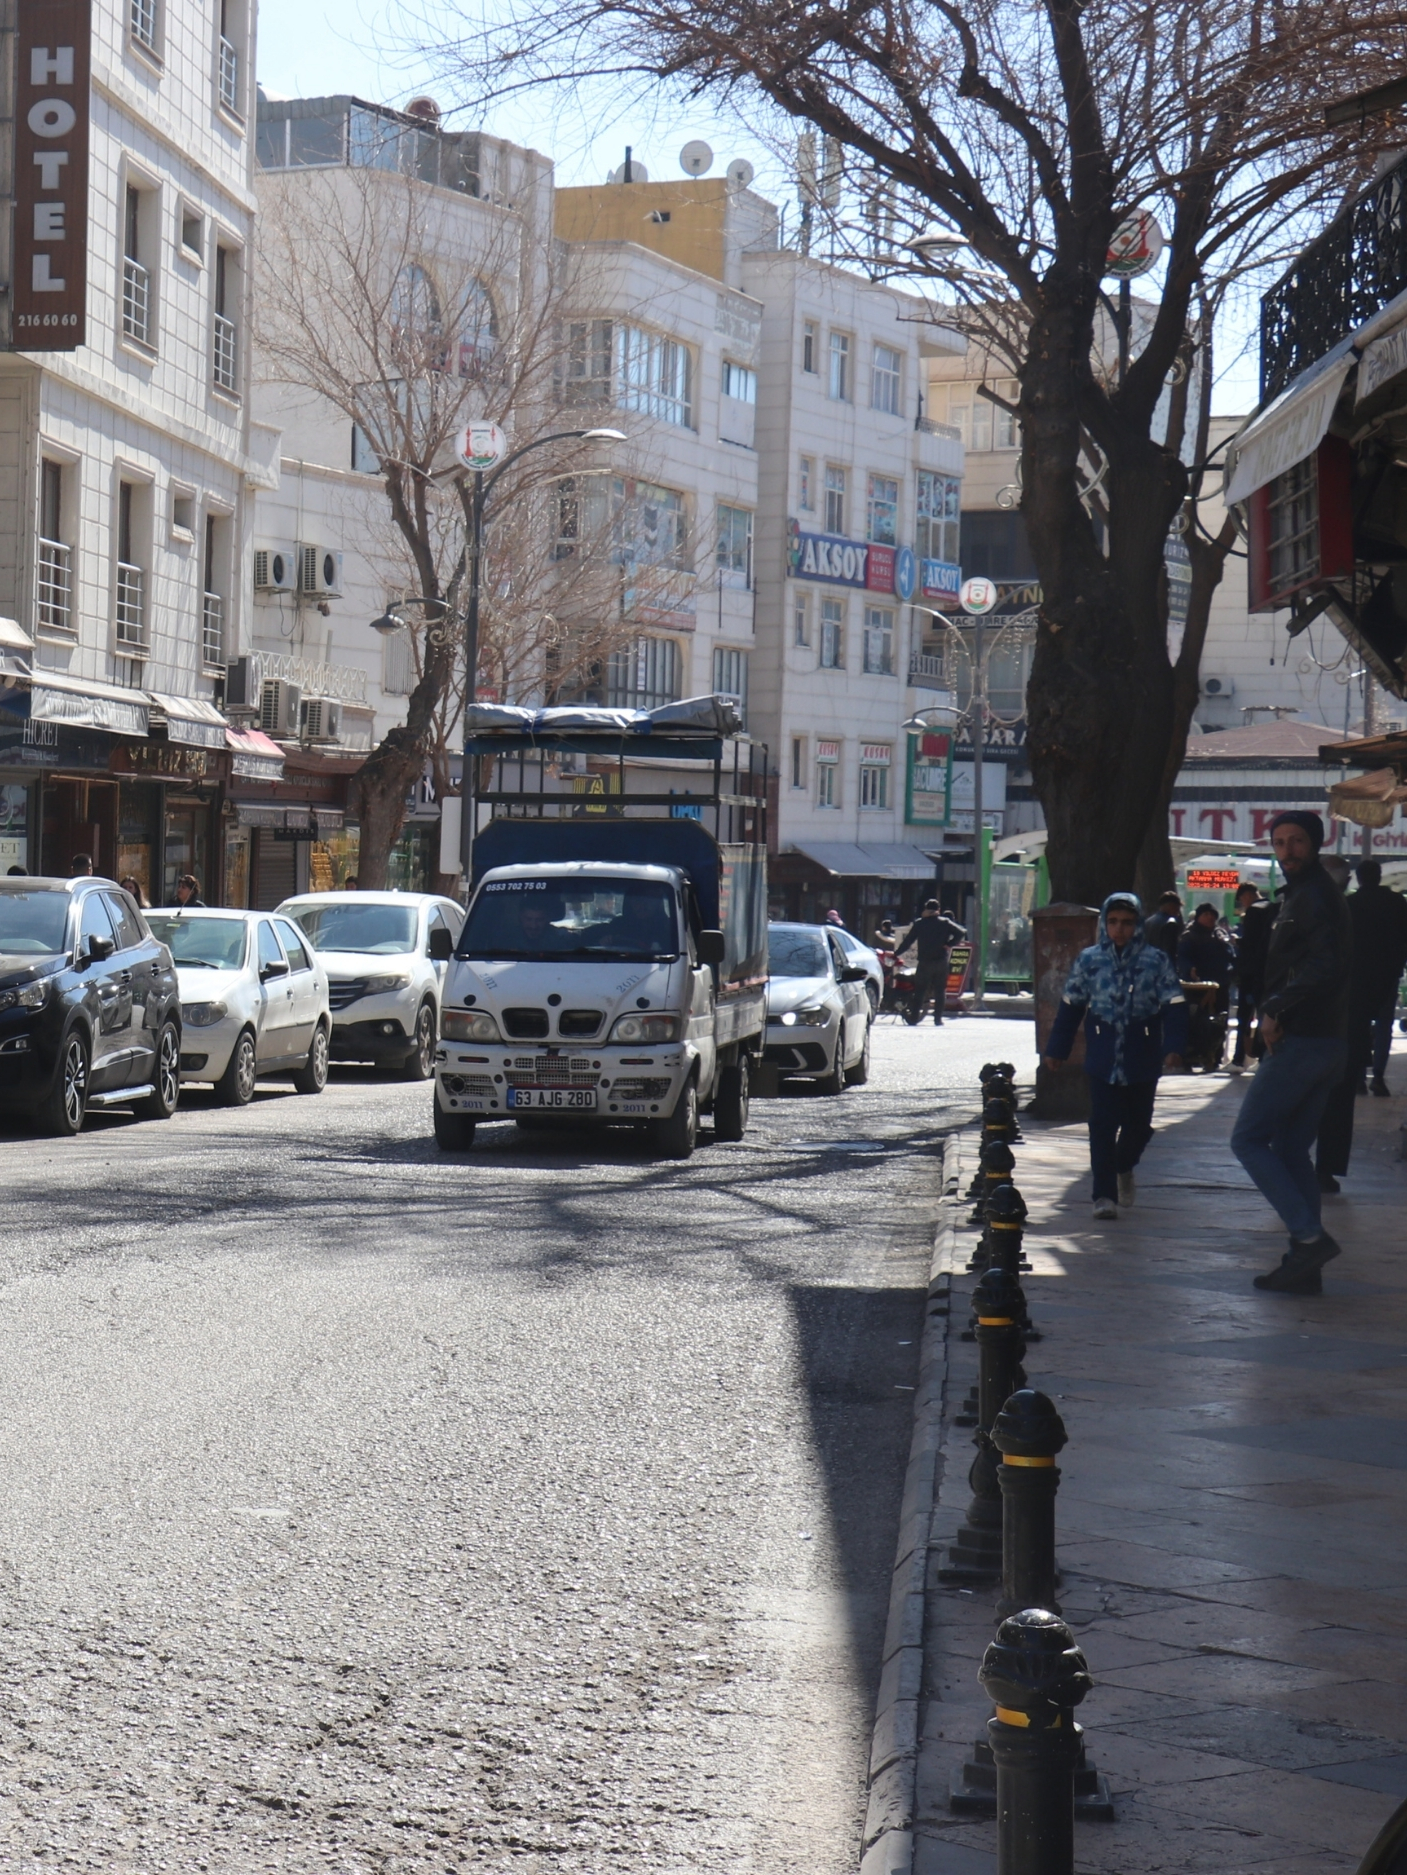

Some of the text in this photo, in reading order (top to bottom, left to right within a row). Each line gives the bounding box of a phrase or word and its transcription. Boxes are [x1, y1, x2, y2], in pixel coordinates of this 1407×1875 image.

[27, 46, 76, 292] HOTEL
[18, 313, 78, 327] 216 60 60
[802, 538, 869, 583] AKSOY
[926, 565, 959, 593] AKSOY
[486, 881, 547, 892] 0553 702 75 03
[479, 972, 498, 990] 2011
[616, 974, 641, 994] 2011
[462, 1099, 484, 1109] 2011
[515, 1090, 592, 1107] 63 AJG 280
[623, 1103, 646, 1113] 2011
